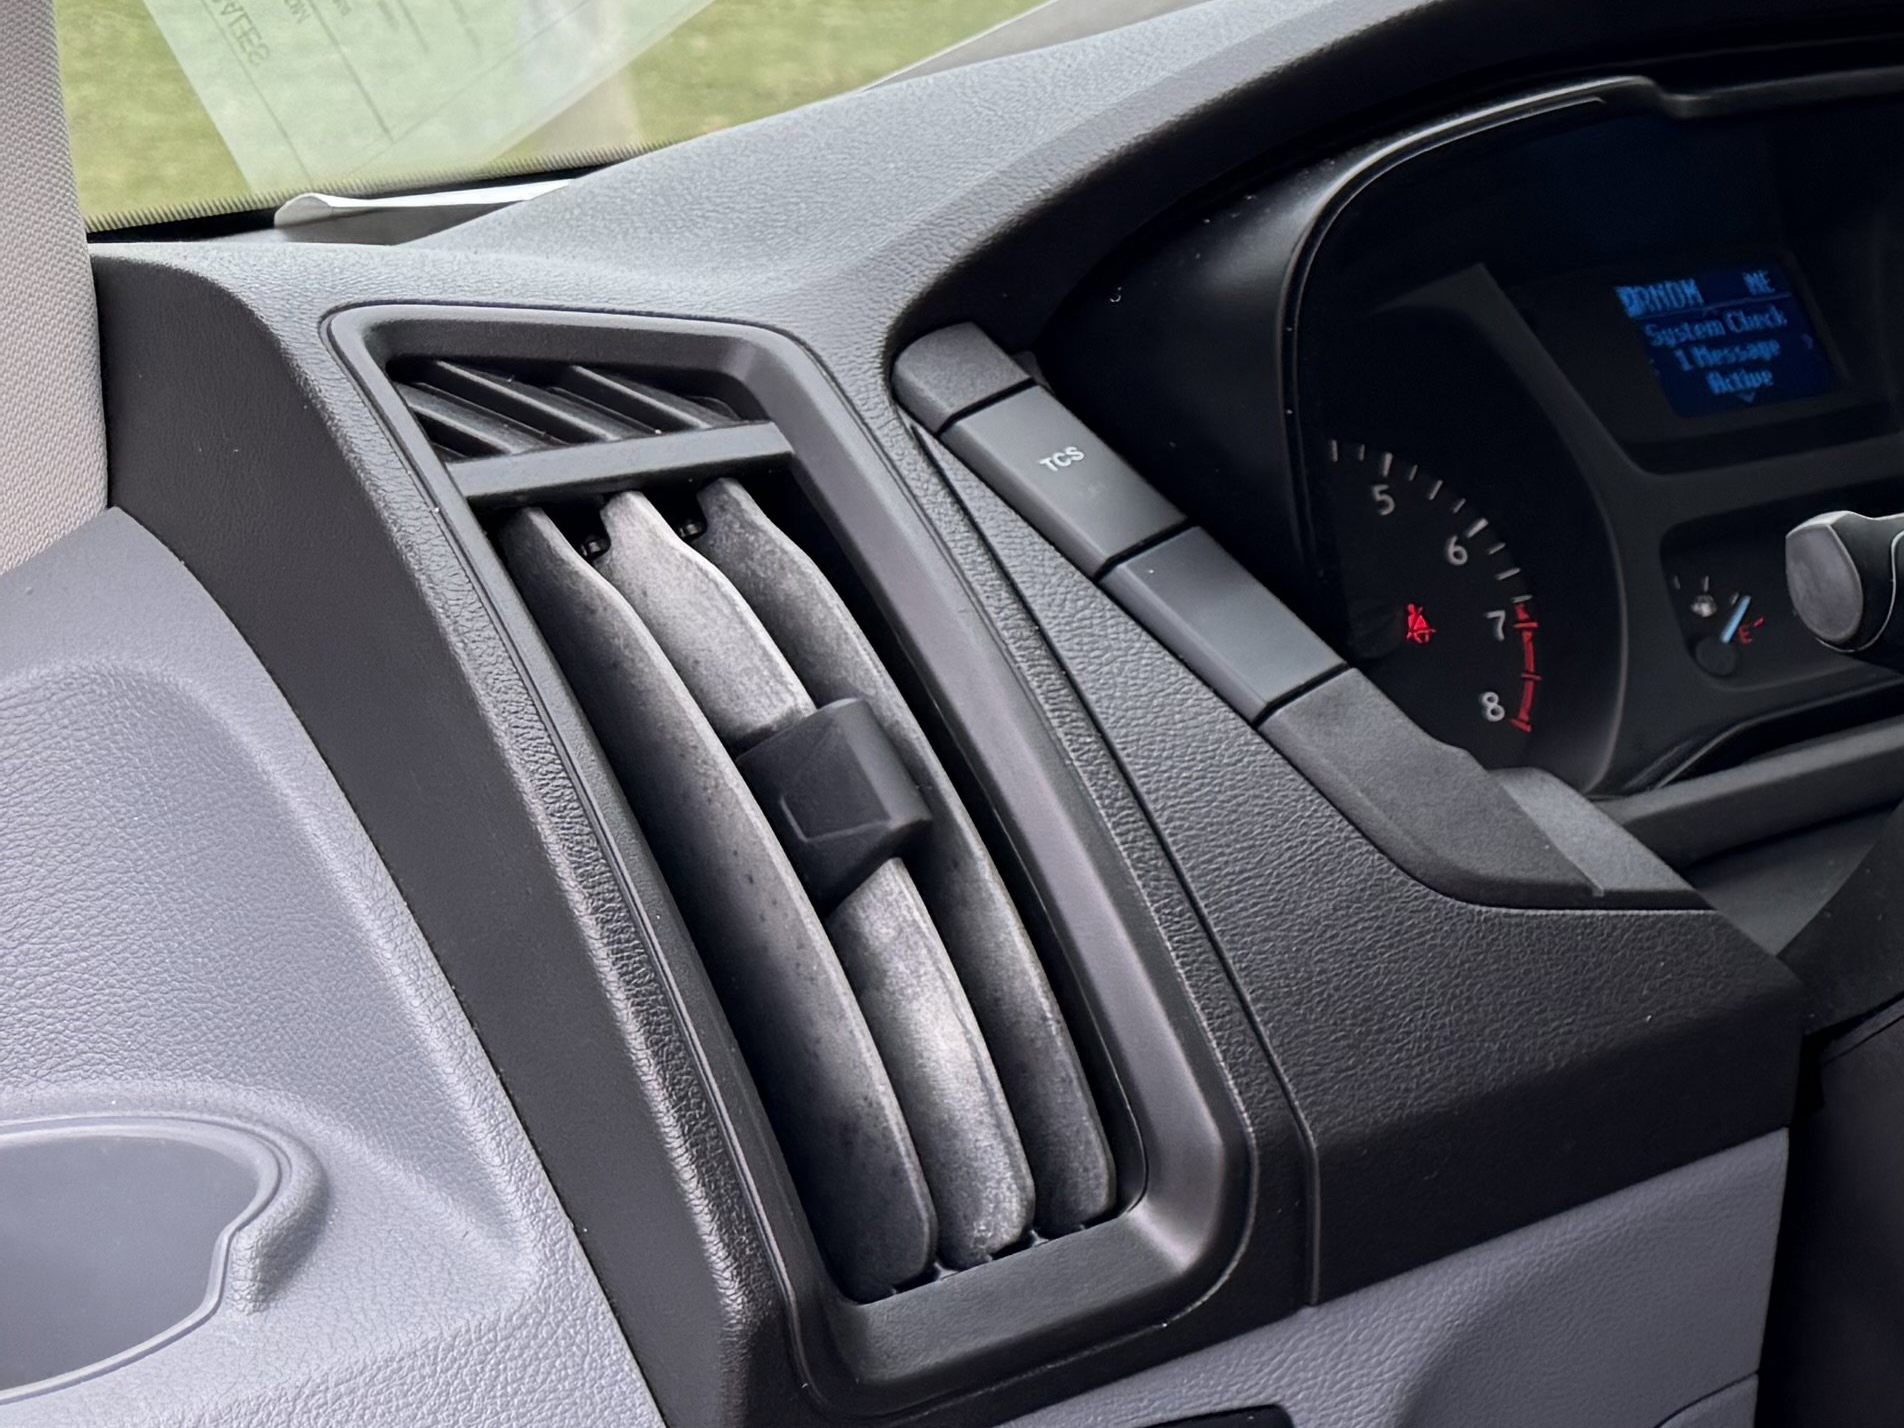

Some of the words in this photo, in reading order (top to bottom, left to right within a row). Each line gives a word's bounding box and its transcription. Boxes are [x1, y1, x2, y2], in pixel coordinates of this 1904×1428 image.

[1645, 319, 1726, 348] System
[1725, 305, 1788, 334] Check
[1674, 348, 1694, 372] 1
[1691, 338, 1781, 368] Message
[1705, 368, 1774, 395] Active
[1039, 446, 1085, 472] TCS
[1371, 484, 1396, 516] 5
[1445, 535, 1469, 566] 6
[1484, 610, 1506, 641] 7
[1479, 690, 1505, 722] 8
